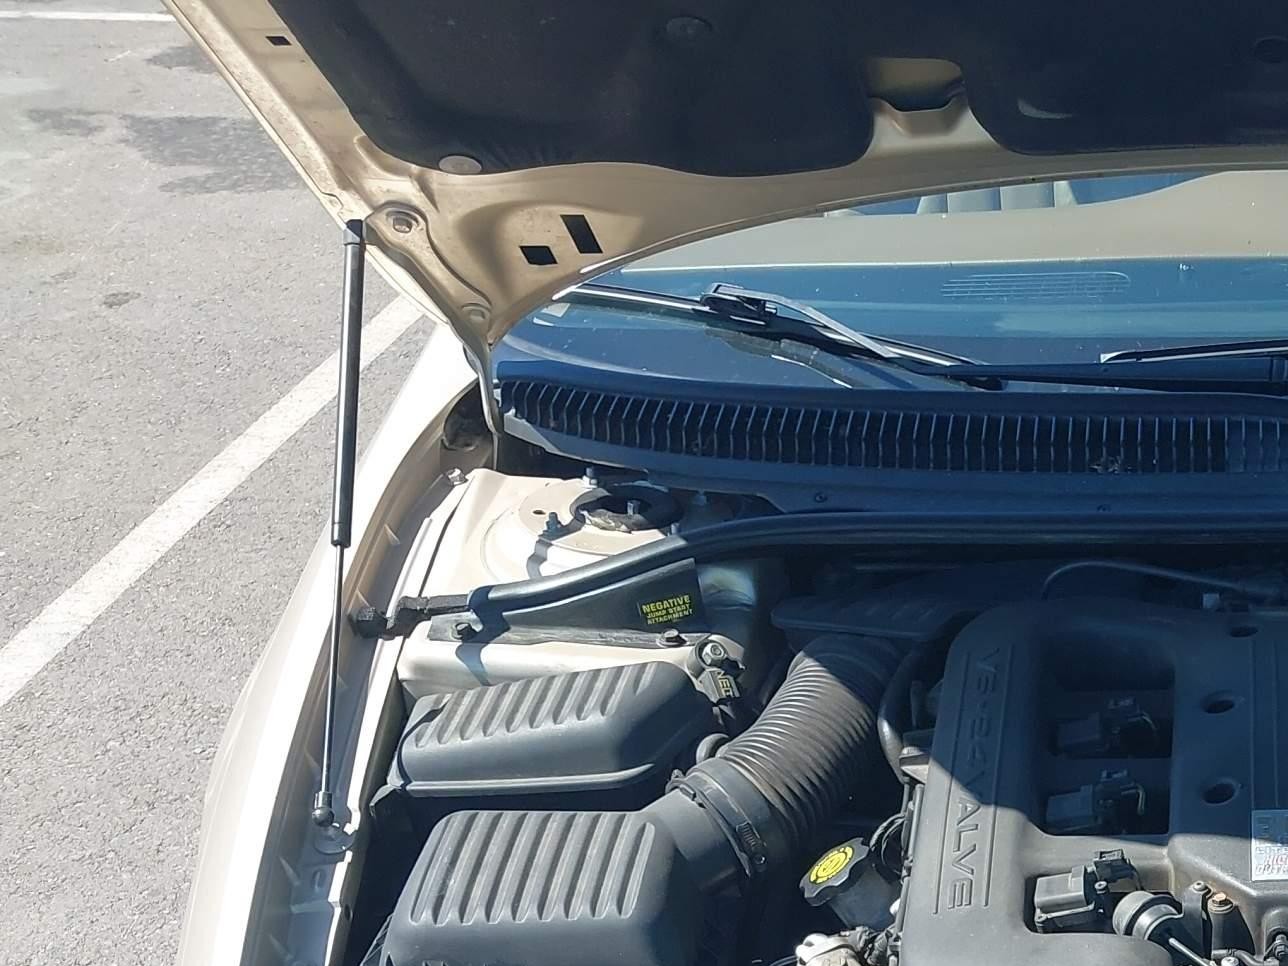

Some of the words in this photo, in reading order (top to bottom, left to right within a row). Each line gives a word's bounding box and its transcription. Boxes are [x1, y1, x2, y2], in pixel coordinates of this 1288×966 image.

[642, 595, 690, 613] NEGATIVE
[647, 610, 667, 618] JUMP
[668, 603, 690, 614] START
